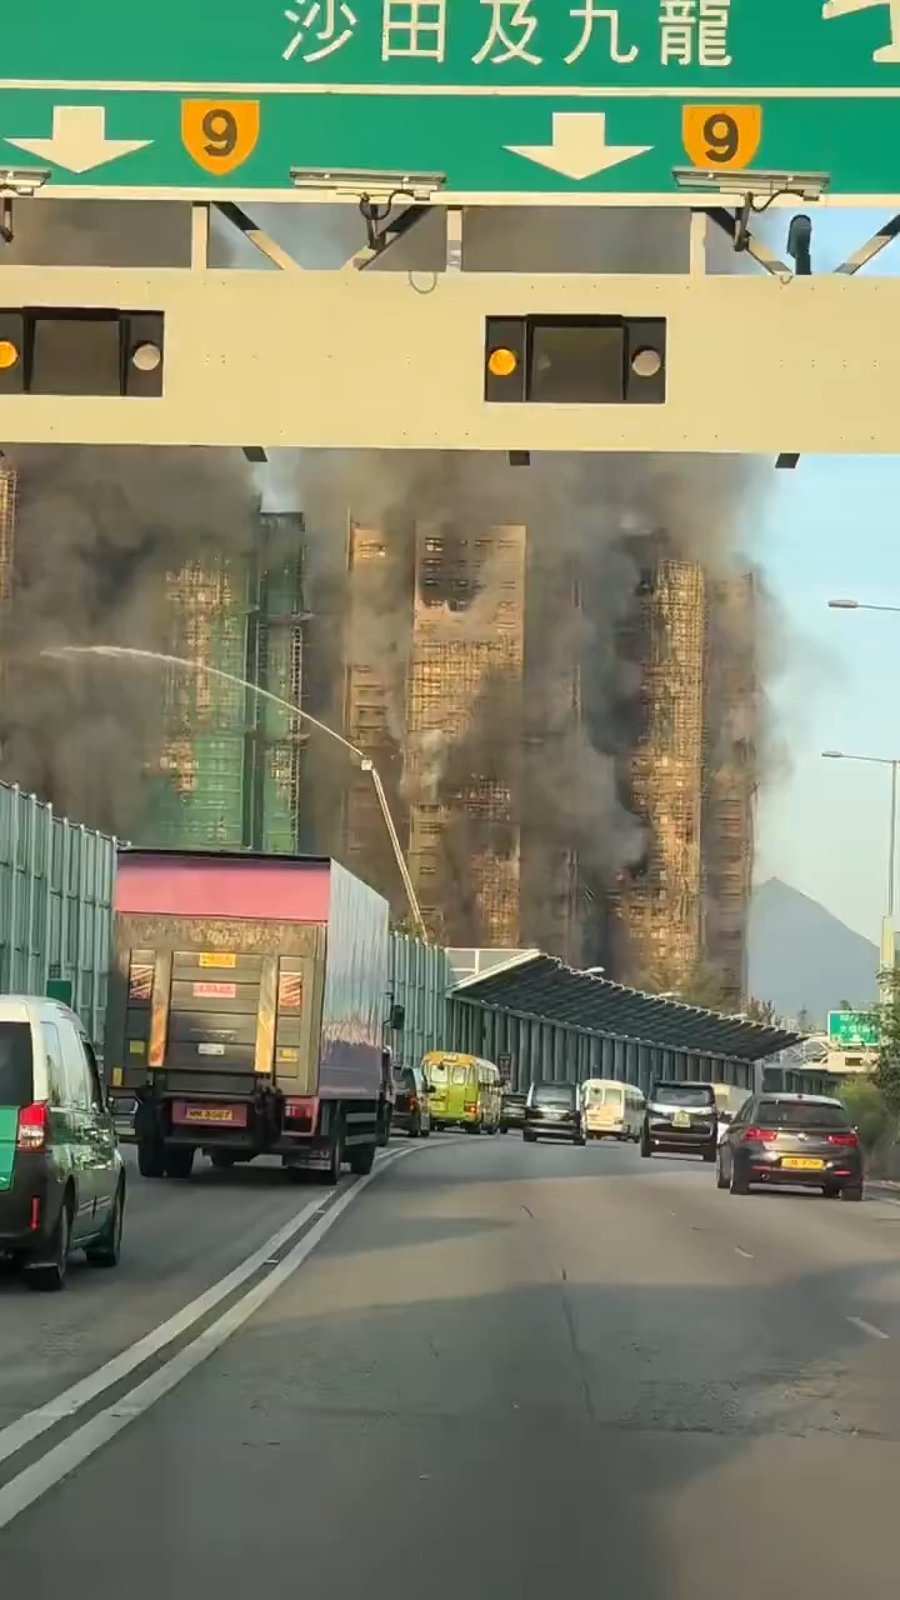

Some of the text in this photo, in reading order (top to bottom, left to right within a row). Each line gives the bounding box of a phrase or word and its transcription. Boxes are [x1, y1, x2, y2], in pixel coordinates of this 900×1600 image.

[282, 0, 732, 67] 沙田及九龍
[202, 108, 238, 157] 9
[702, 112, 740, 163] 9
